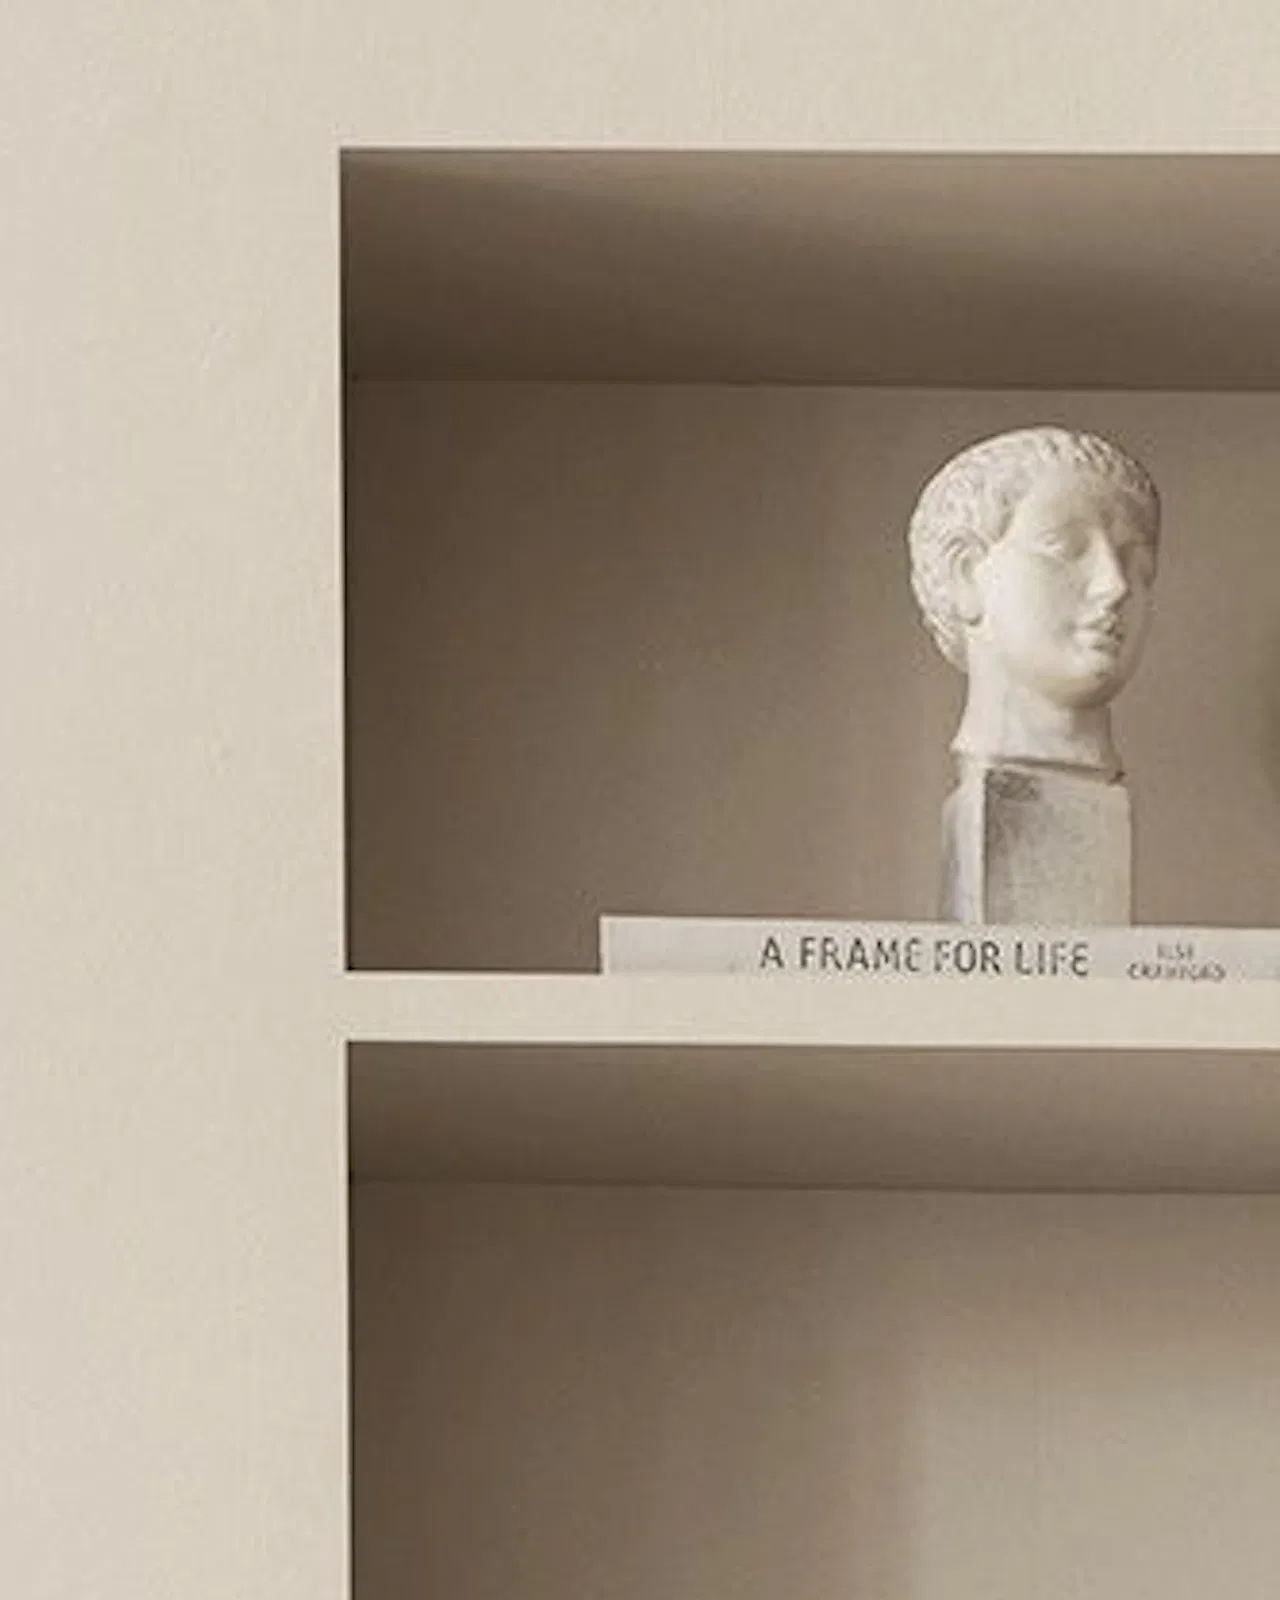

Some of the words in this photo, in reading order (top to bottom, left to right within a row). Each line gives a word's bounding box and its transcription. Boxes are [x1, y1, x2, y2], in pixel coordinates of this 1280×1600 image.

[759, 936, 785, 969] A
[799, 936, 922, 973] FRAME
[934, 940, 1002, 975] FOR
[1014, 940, 1090, 976] LIFE
